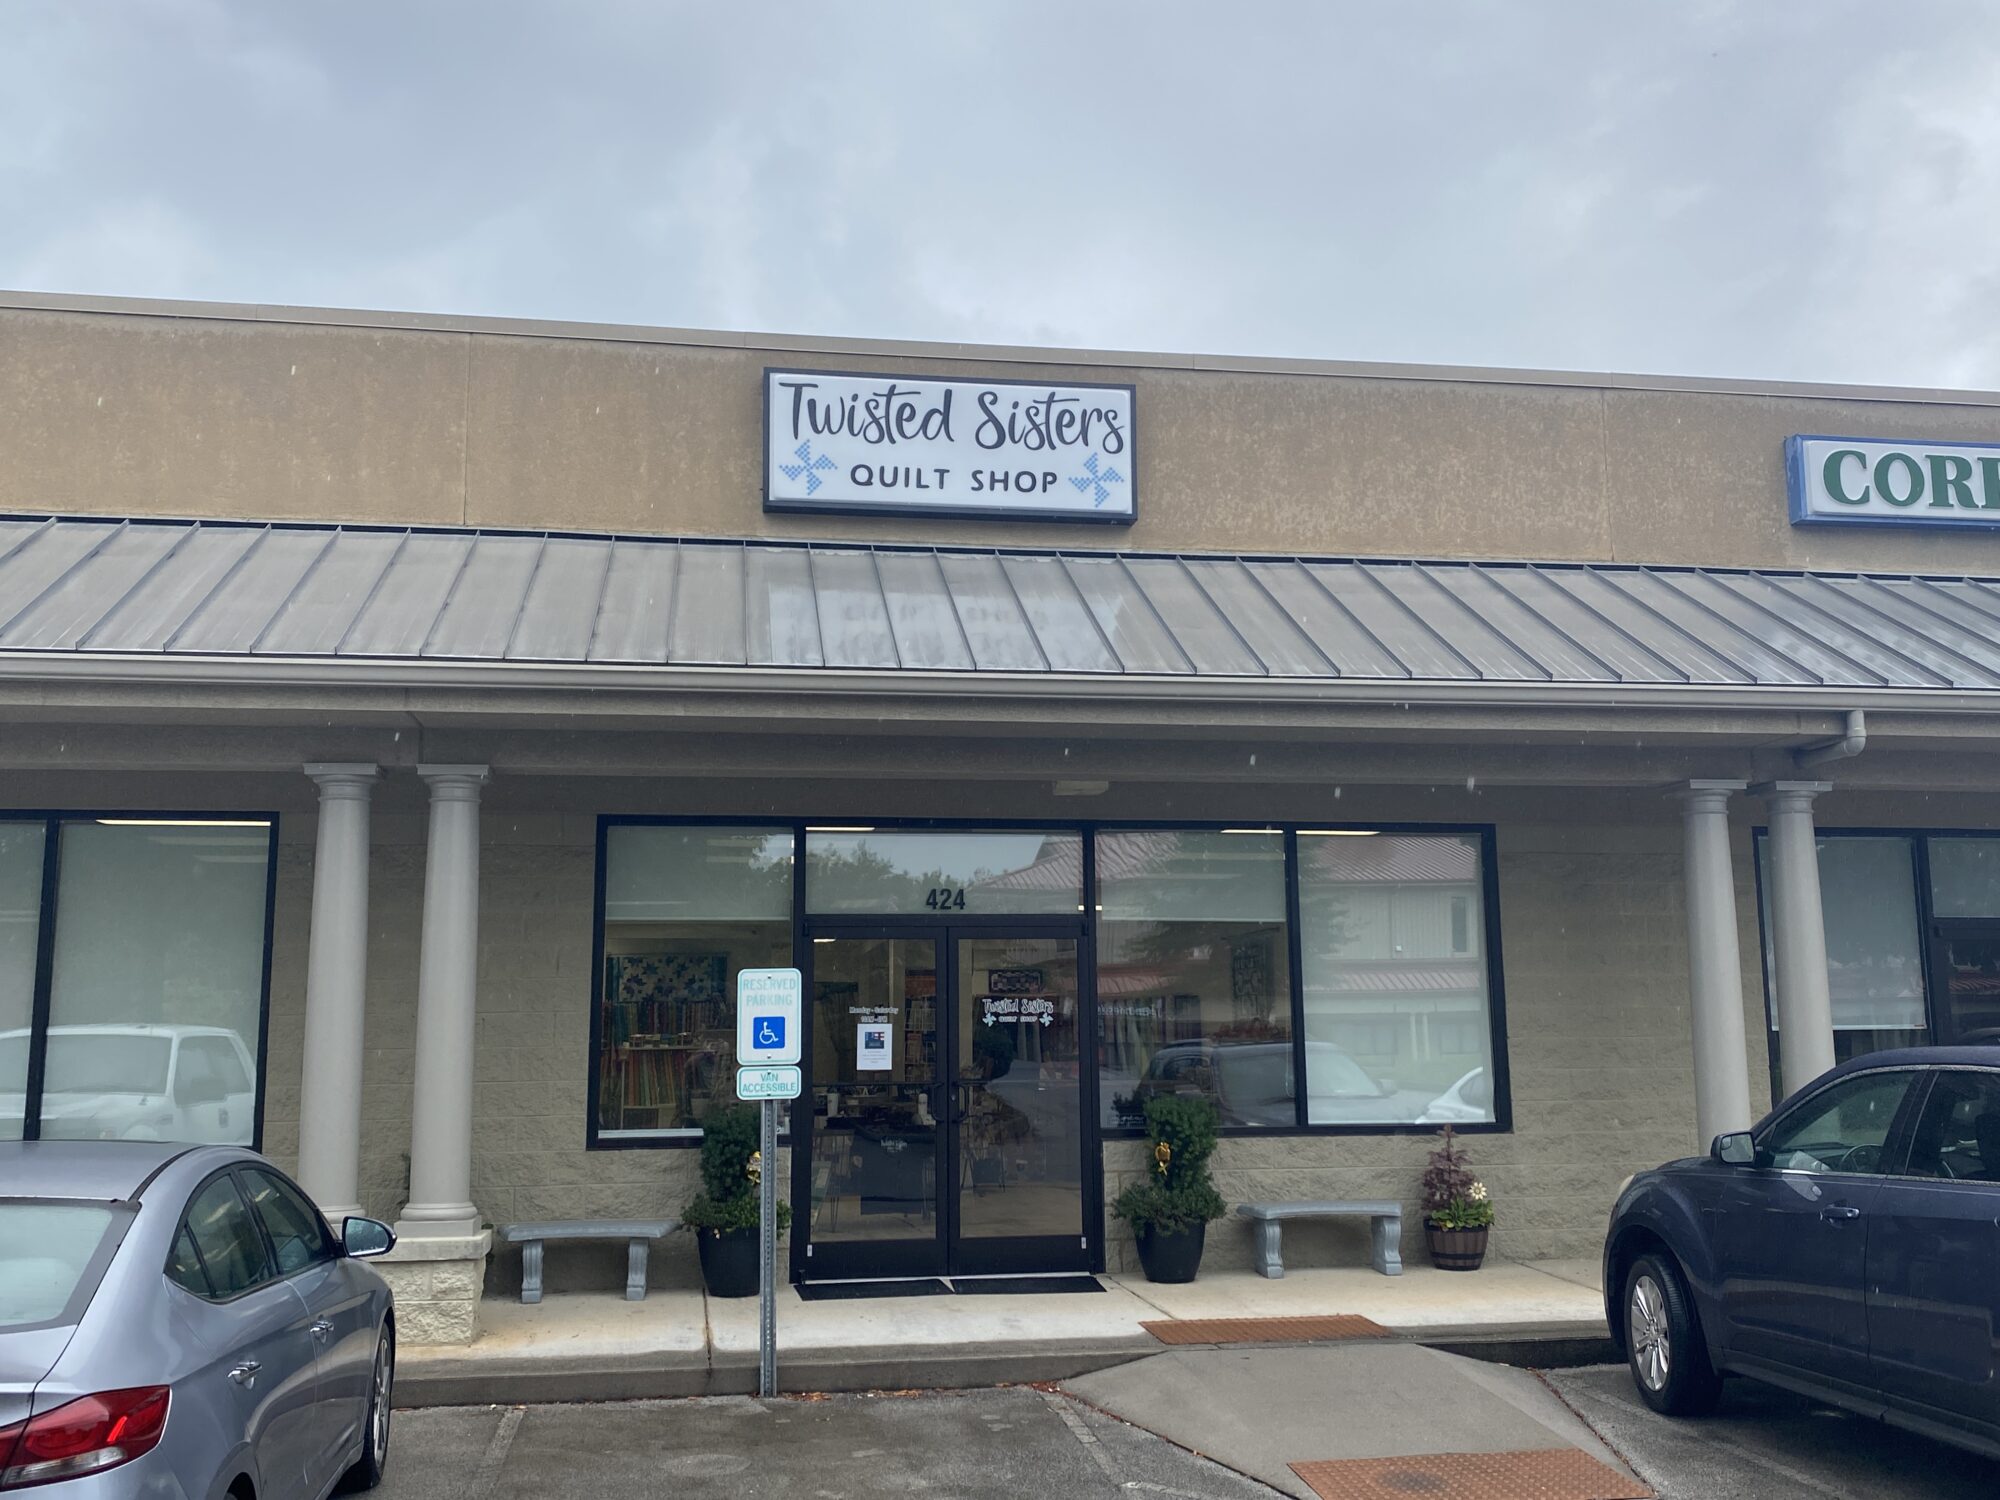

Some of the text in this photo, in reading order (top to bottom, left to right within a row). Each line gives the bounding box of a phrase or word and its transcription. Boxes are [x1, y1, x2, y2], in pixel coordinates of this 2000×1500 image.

[778, 382, 1125, 455] Twisted Sisters
[849, 463, 1058, 493] QUILT SHOP
[925, 888, 966, 910] 424
[743, 978, 796, 991] RESERVED
[746, 994, 792, 1007] PARKING
[1020, 998, 1054, 1014] Sisters
[760, 1072, 779, 1082] VAN
[742, 1082, 796, 1093] ACCESSIBLE
